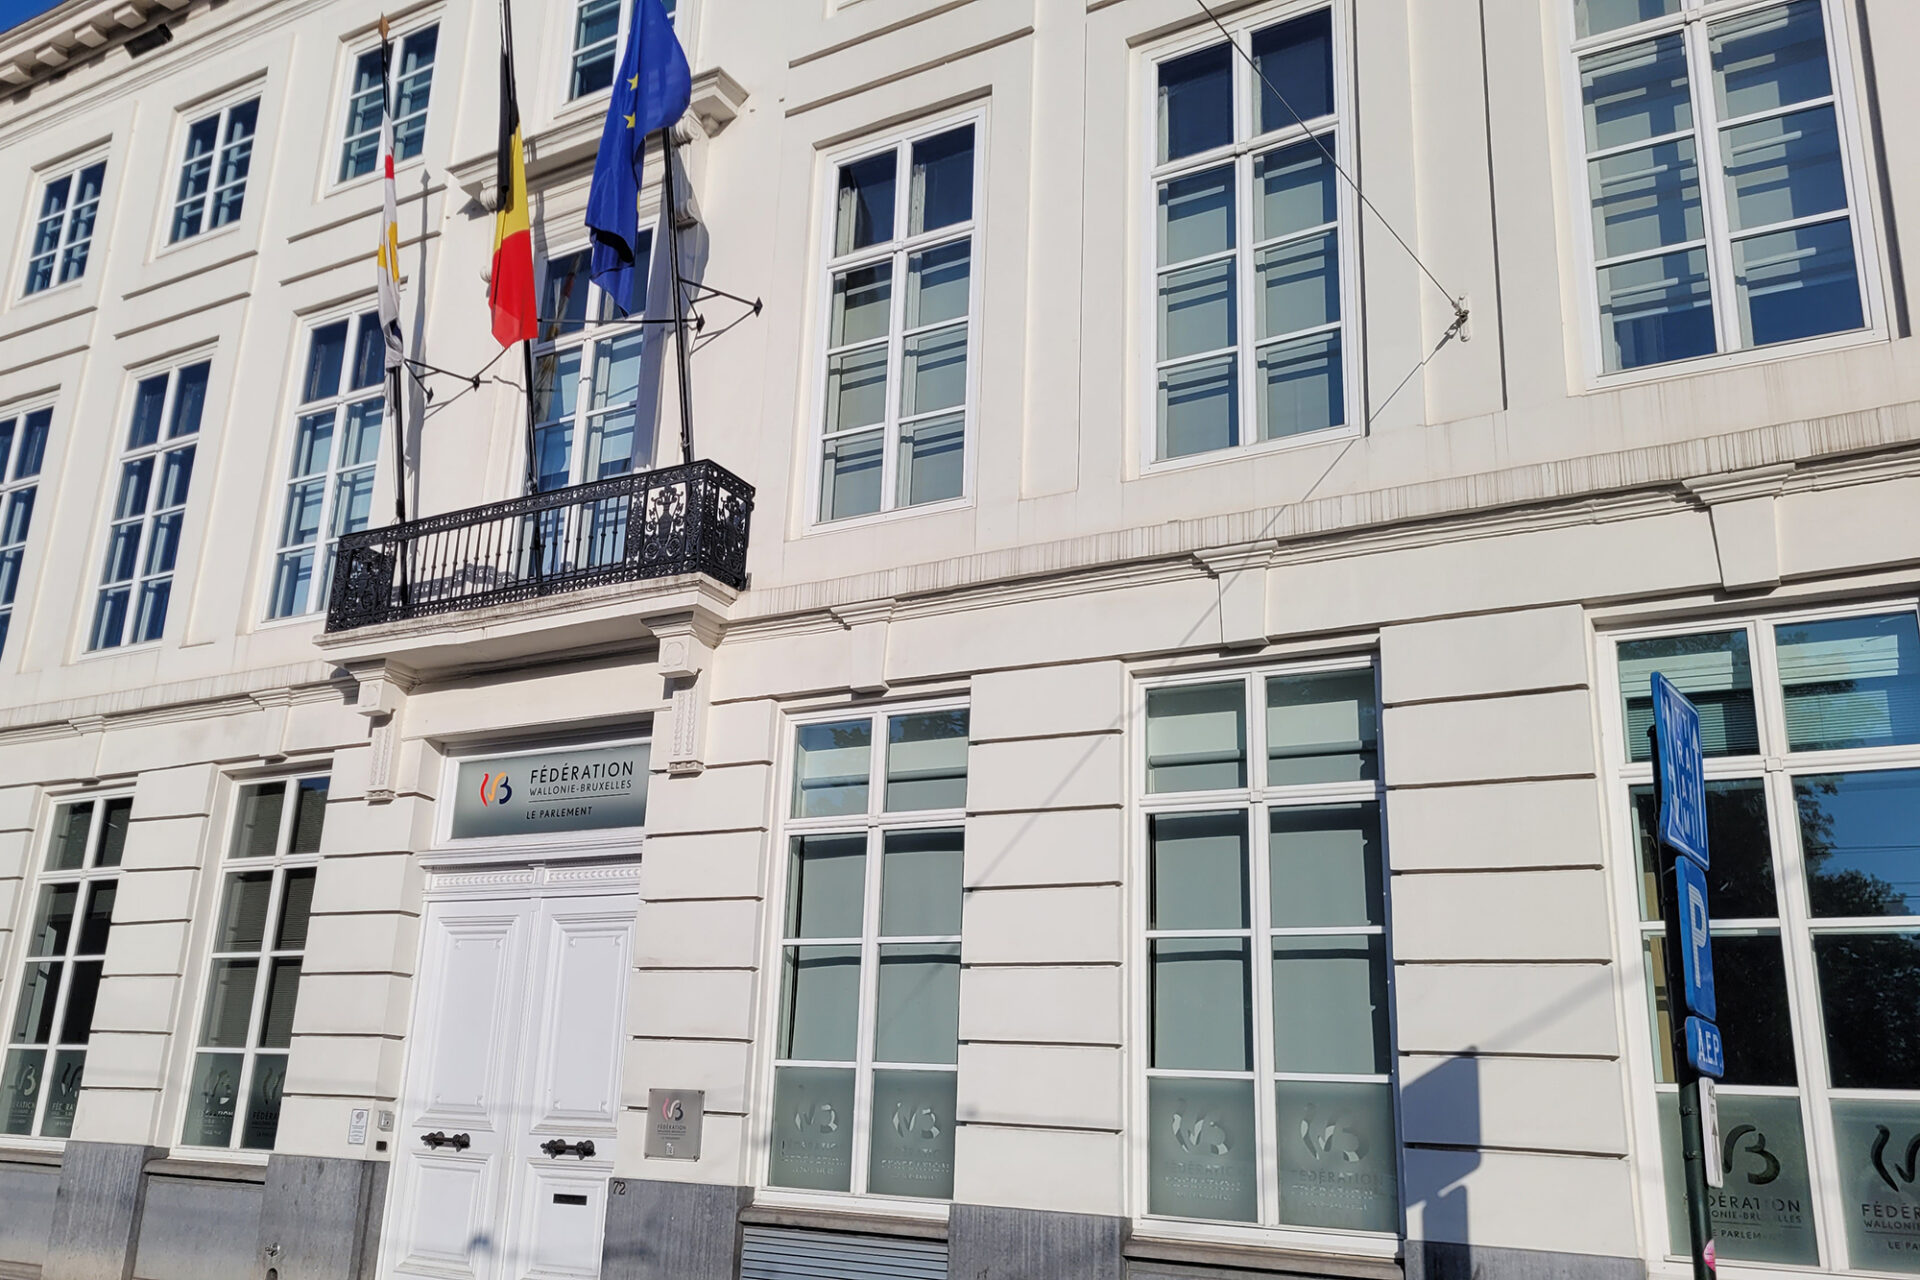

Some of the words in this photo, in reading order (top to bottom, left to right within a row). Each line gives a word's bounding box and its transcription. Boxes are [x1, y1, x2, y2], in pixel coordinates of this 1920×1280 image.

[530, 760, 634, 784] FÉDÉRATION
[529, 779, 632, 796] WALLONIE-BRUXELLES
[526, 810, 536, 820] LE
[539, 806, 593, 819] PARLEMENT
[1687, 882, 1707, 989] P
[613, 1180, 626, 1196] 72
